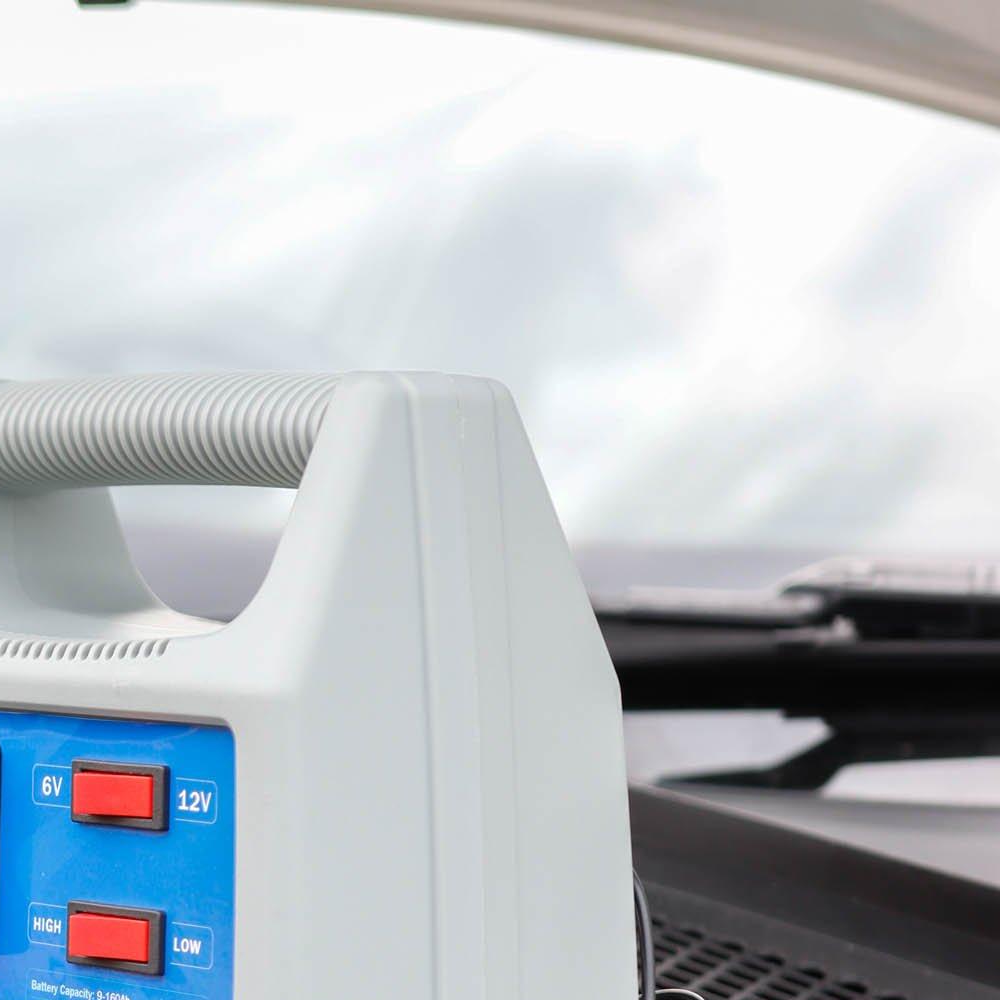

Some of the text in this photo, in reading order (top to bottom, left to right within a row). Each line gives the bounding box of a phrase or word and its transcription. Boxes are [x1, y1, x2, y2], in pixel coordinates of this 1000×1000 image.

[42, 776, 63, 797] 6V
[177, 789, 212, 813] 12V
[33, 916, 62, 934] HIGH
[173, 937, 201, 955] LOW
[31, 979, 58, 996] Battery
[59, 985, 95, 1000] Capacity:
